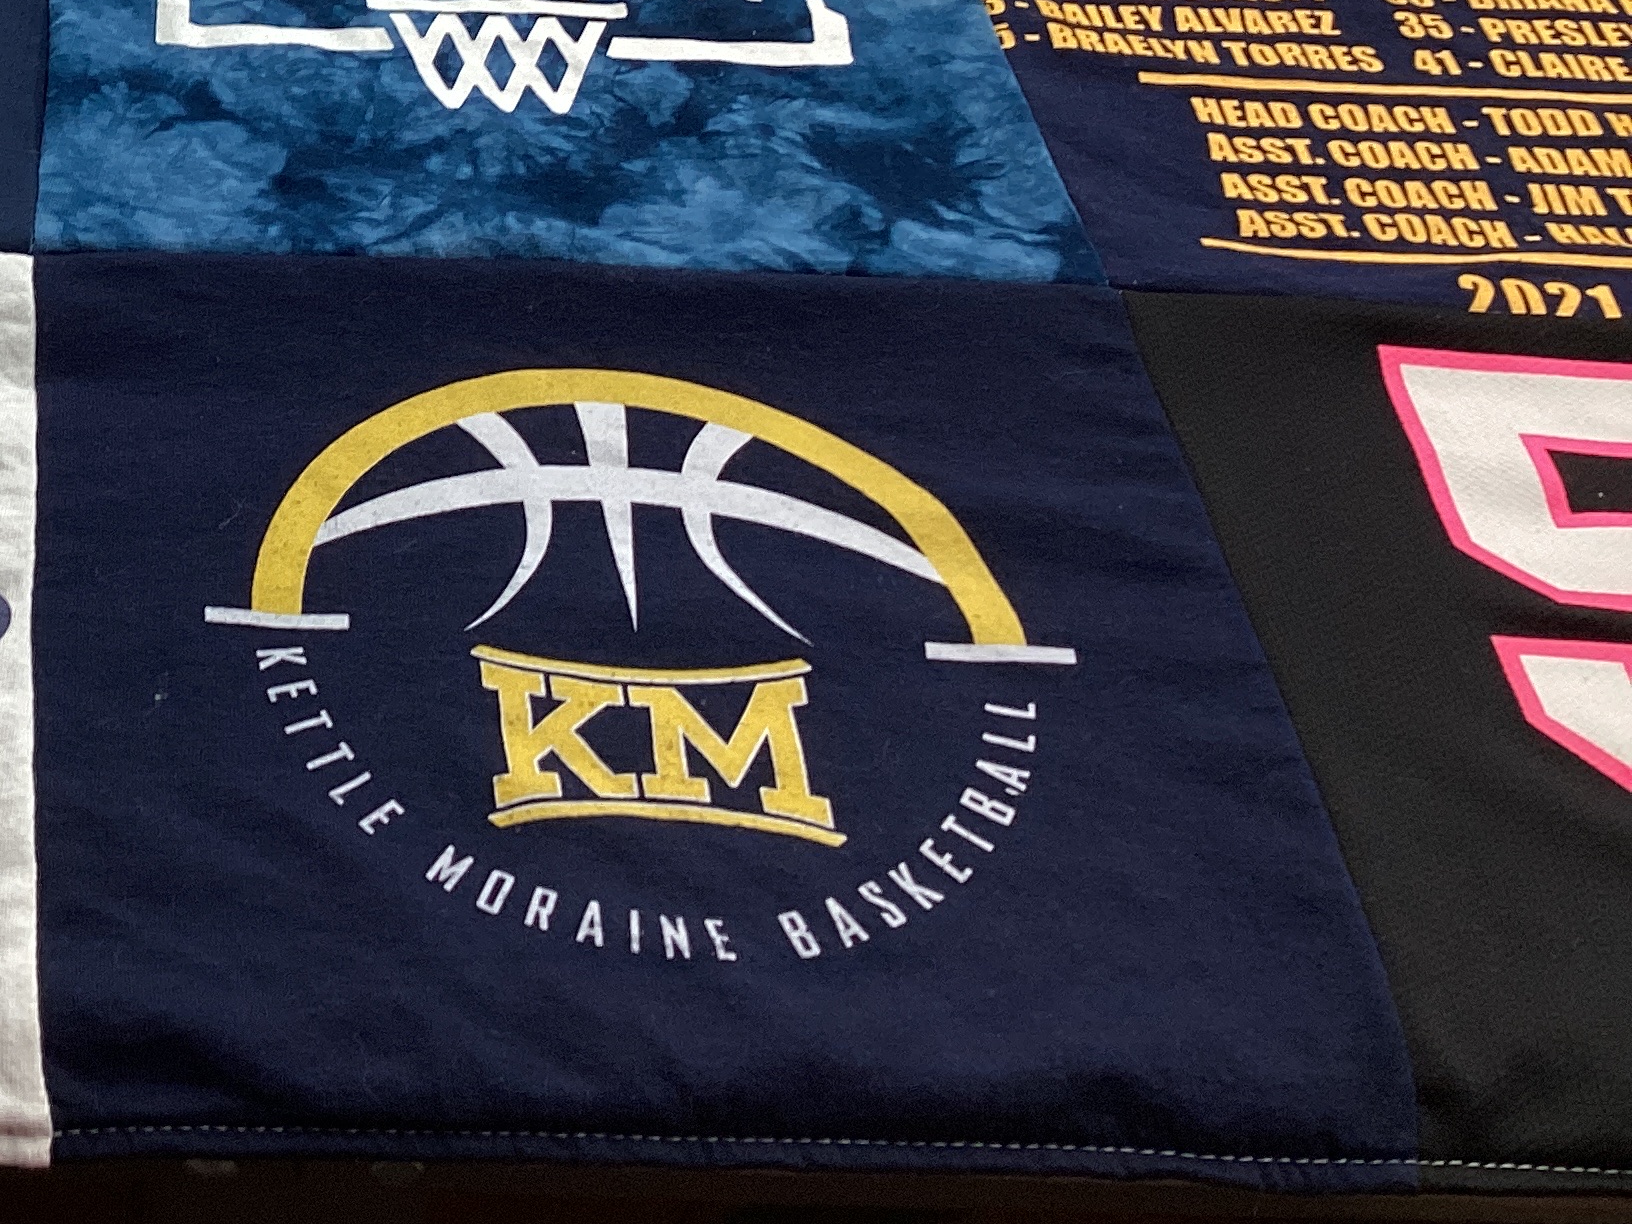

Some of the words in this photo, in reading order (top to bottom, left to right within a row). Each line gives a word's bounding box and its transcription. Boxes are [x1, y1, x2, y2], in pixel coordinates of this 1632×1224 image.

[1173, 5, 1343, 37] ALVAREZ
[1392, 10, 1455, 40] 35
[1046, 21, 1222, 66] BRAELYN
[1221, 39, 1386, 75] TORRES
[1412, 48, 1463, 76] 41
[1487, 48, 1631, 82] CLAIRE
[1190, 95, 1304, 130] HEAD
[1306, 101, 1458, 134] COACH
[1480, 106, 1606, 137] TODD
[1207, 132, 1326, 166] ASST.
[1327, 139, 1481, 172] COACH
[1507, 145, 1632, 178] ADAM
[1220, 172, 1342, 207] ASST.
[1343, 177, 1500, 212] COACH
[1525, 182, 1609, 216] JIM
[1235, 208, 1361, 240] ASST.
[1362, 212, 1520, 249] COACH
[476, 656, 838, 832] KM
[255, 644, 406, 836] KETTLE
[424, 842, 739, 962] MORAINE
[775, 699, 1038, 960] BASKETBALL
